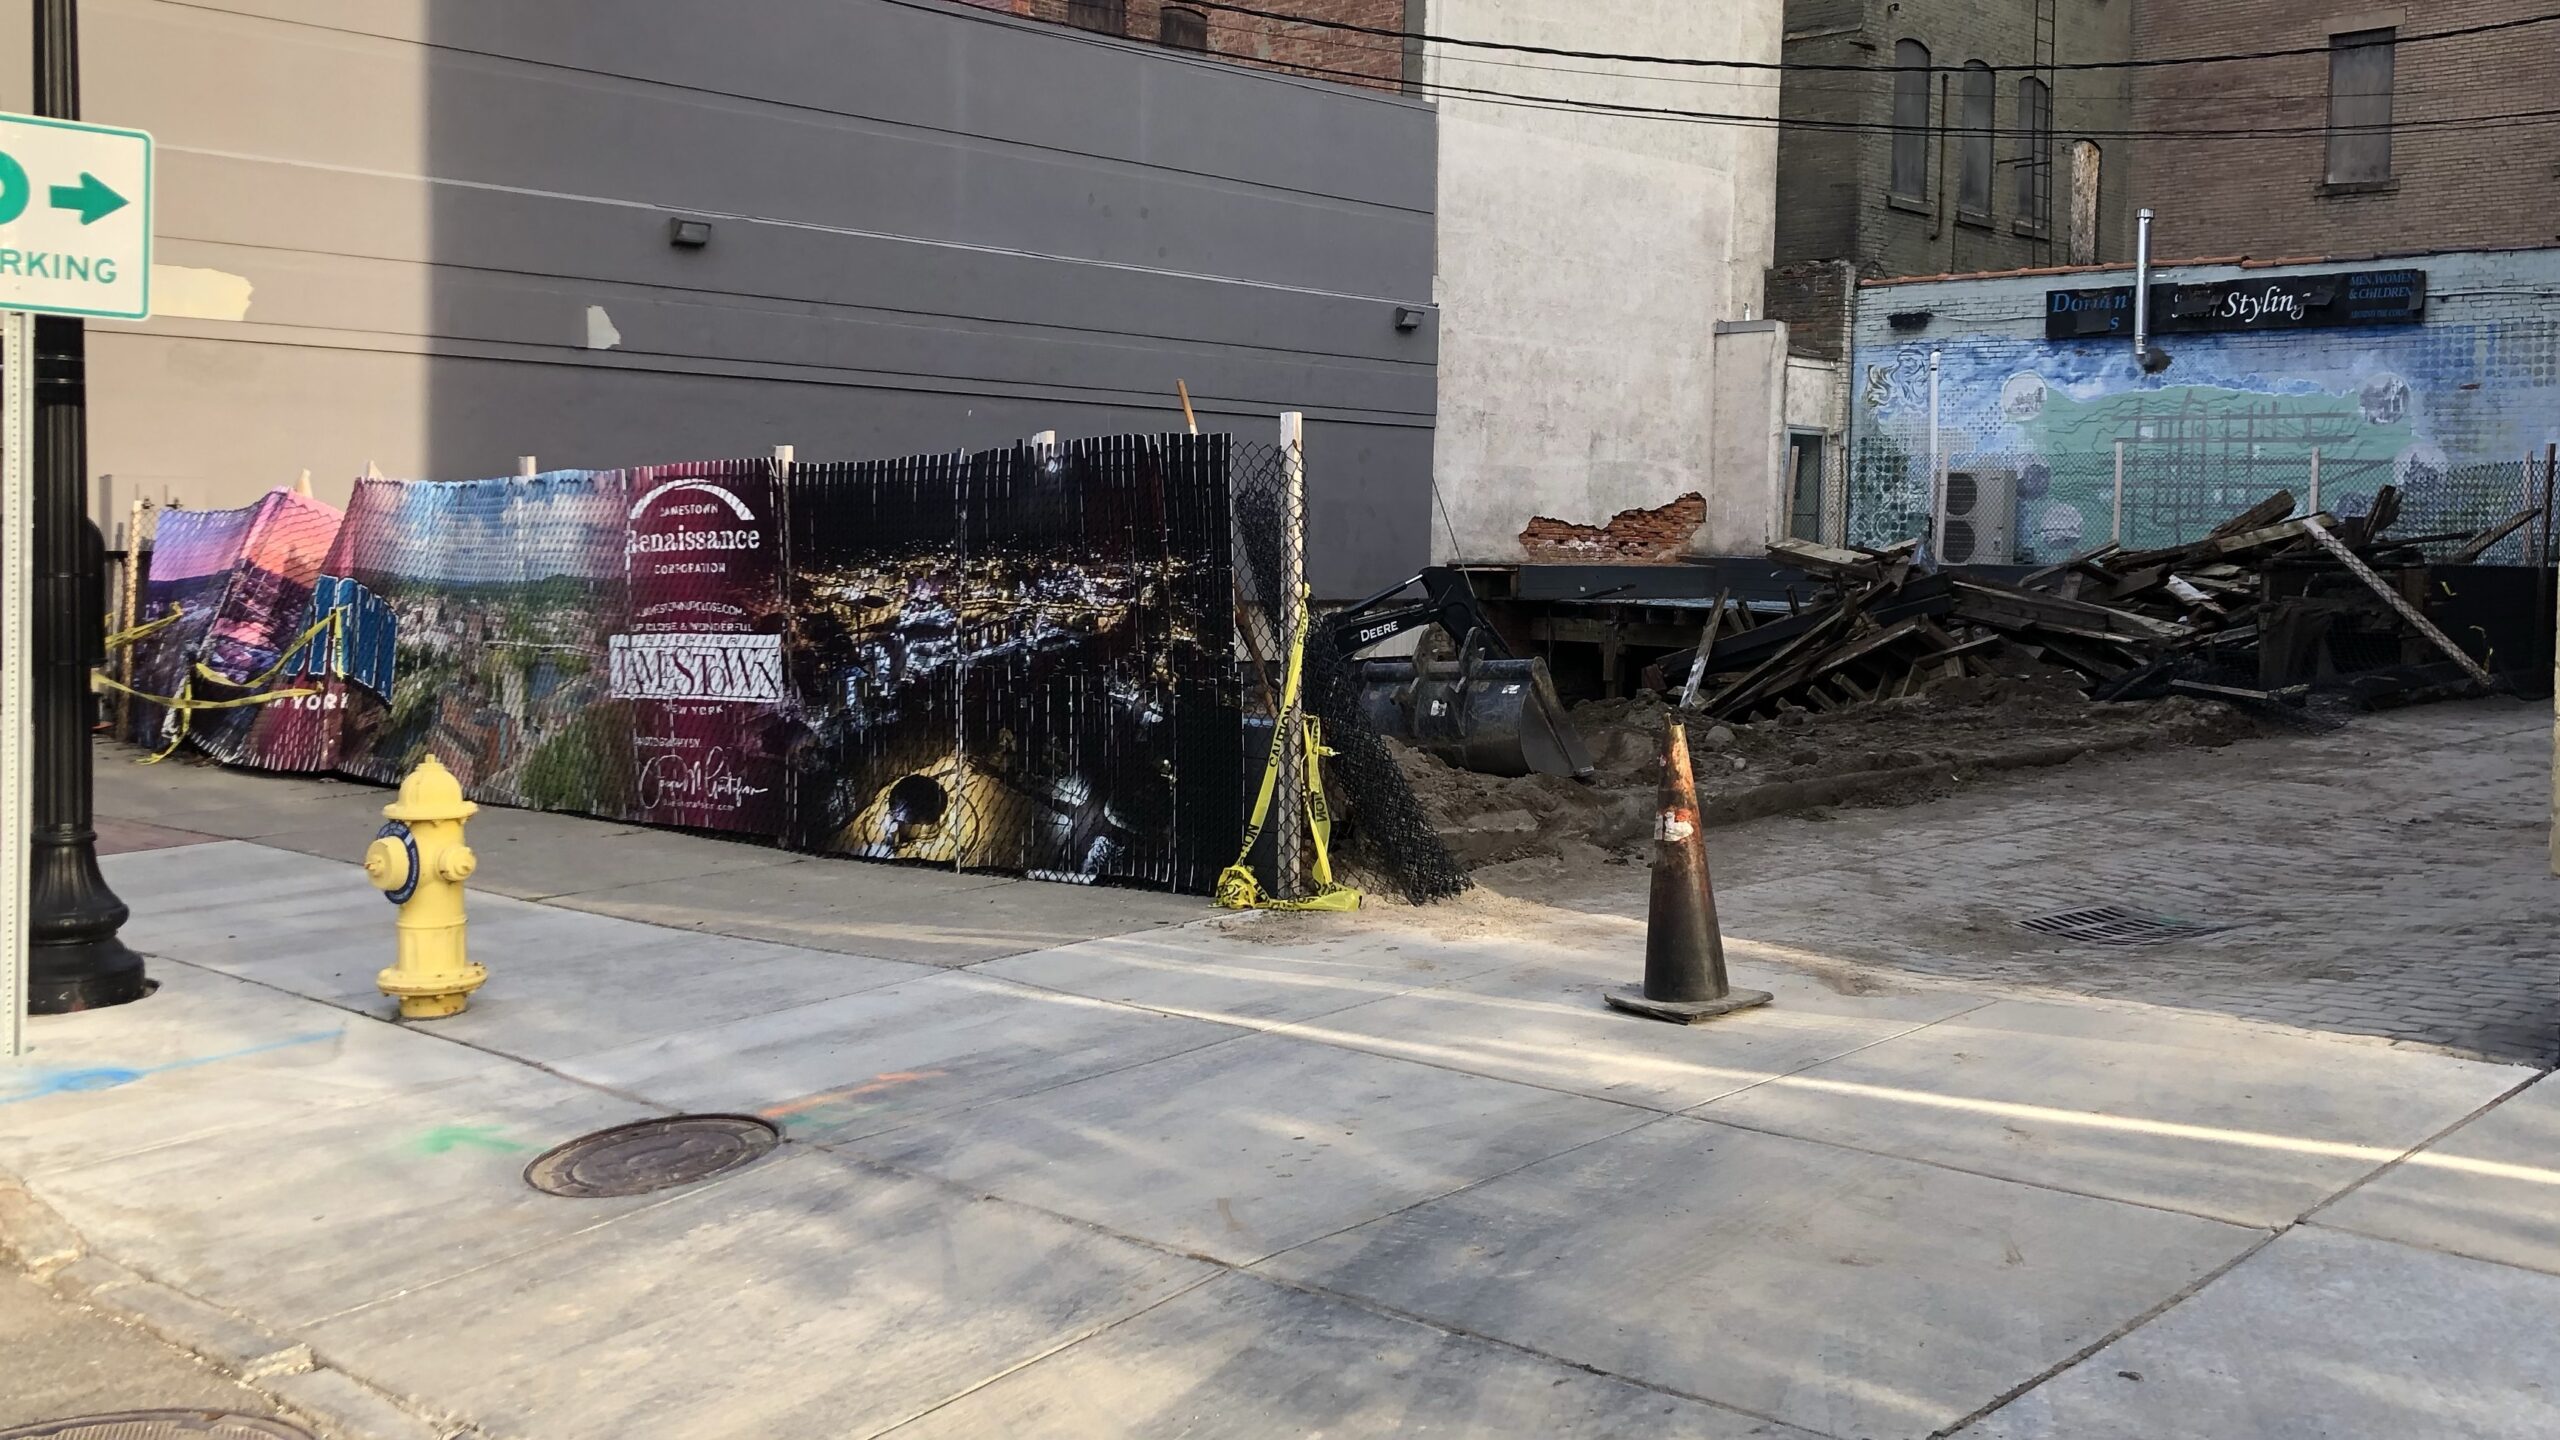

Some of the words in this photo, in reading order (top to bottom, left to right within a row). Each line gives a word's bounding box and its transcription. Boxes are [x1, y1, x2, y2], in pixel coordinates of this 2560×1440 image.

[659, 503, 719, 518] JAMESTOWN
[625, 524, 761, 554] Renaissance
[654, 562, 726, 575] CORPORATION
[645, 622, 677, 632] CLOSE
[1360, 621, 1399, 642] DEERE
[612, 646, 781, 699] JAMESTOWN
